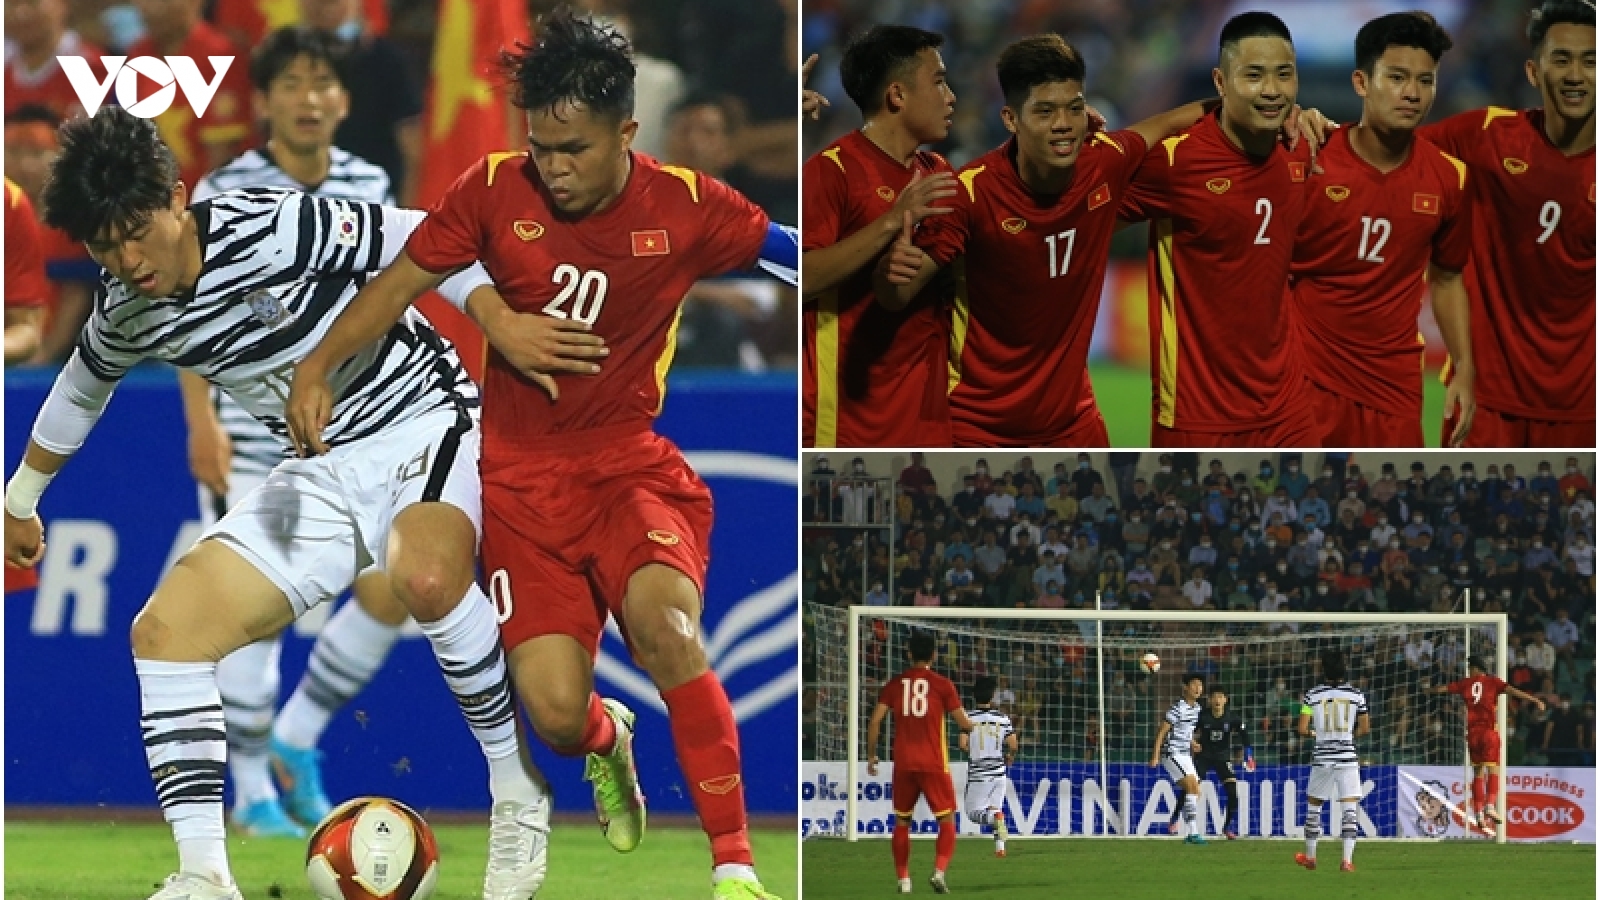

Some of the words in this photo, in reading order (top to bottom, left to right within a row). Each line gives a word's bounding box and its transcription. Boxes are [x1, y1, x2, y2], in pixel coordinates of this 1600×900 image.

[1254, 198, 1273, 245] 2
[1357, 216, 1392, 263] 12
[1535, 200, 1562, 244] 9
[1044, 228, 1076, 278] 17
[542, 263, 608, 326] 20
[490, 568, 512, 624] 0
[901, 677, 929, 717] 18
[1322, 697, 1350, 733] 10
[1471, 682, 1483, 705] 9
